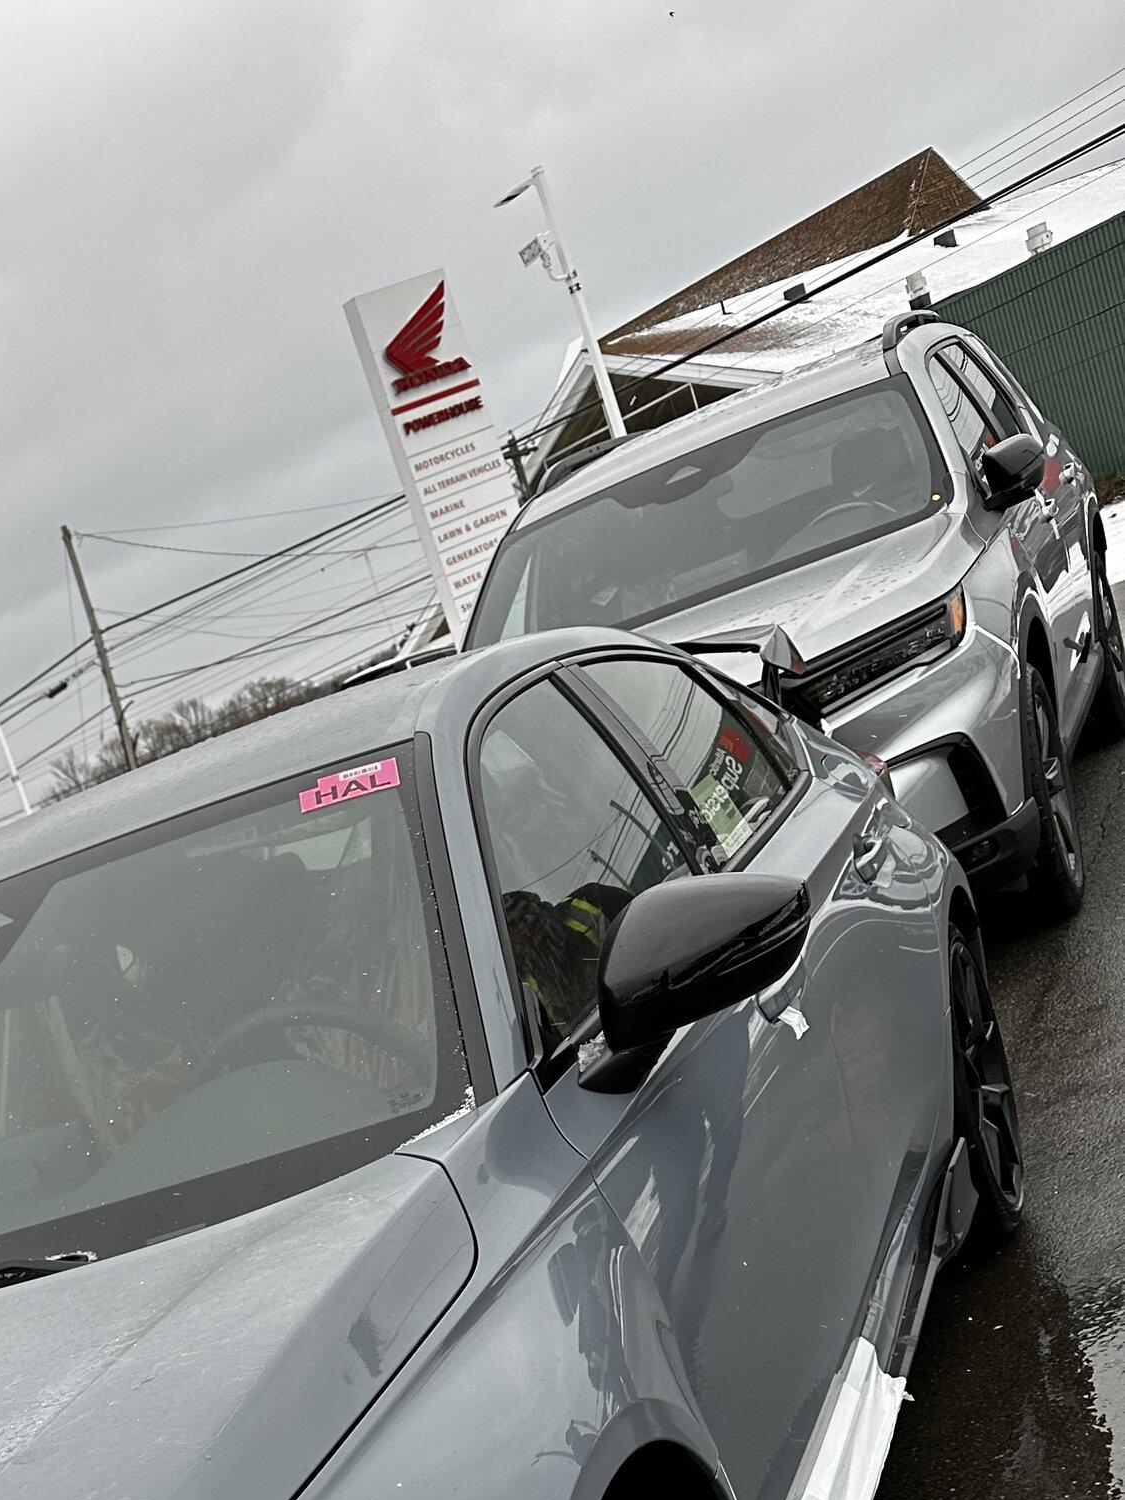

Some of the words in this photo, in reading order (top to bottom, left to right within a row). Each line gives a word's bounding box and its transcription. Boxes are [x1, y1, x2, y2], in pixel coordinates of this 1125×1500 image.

[403, 395, 484, 436] POWERHOUSE
[414, 443, 476, 472] MOTORCYCLES
[423, 484, 438, 496] ALL
[437, 471, 468, 490] TERRAIN
[467, 459, 501, 478] VEHICLES
[430, 499, 466, 519] MARINE
[437, 526, 464, 543] LAWN
[465, 523, 472, 533] &
[473, 509, 508, 528] GARDEN
[453, 571, 483, 589] WATER
[315, 774, 391, 805] HAL
